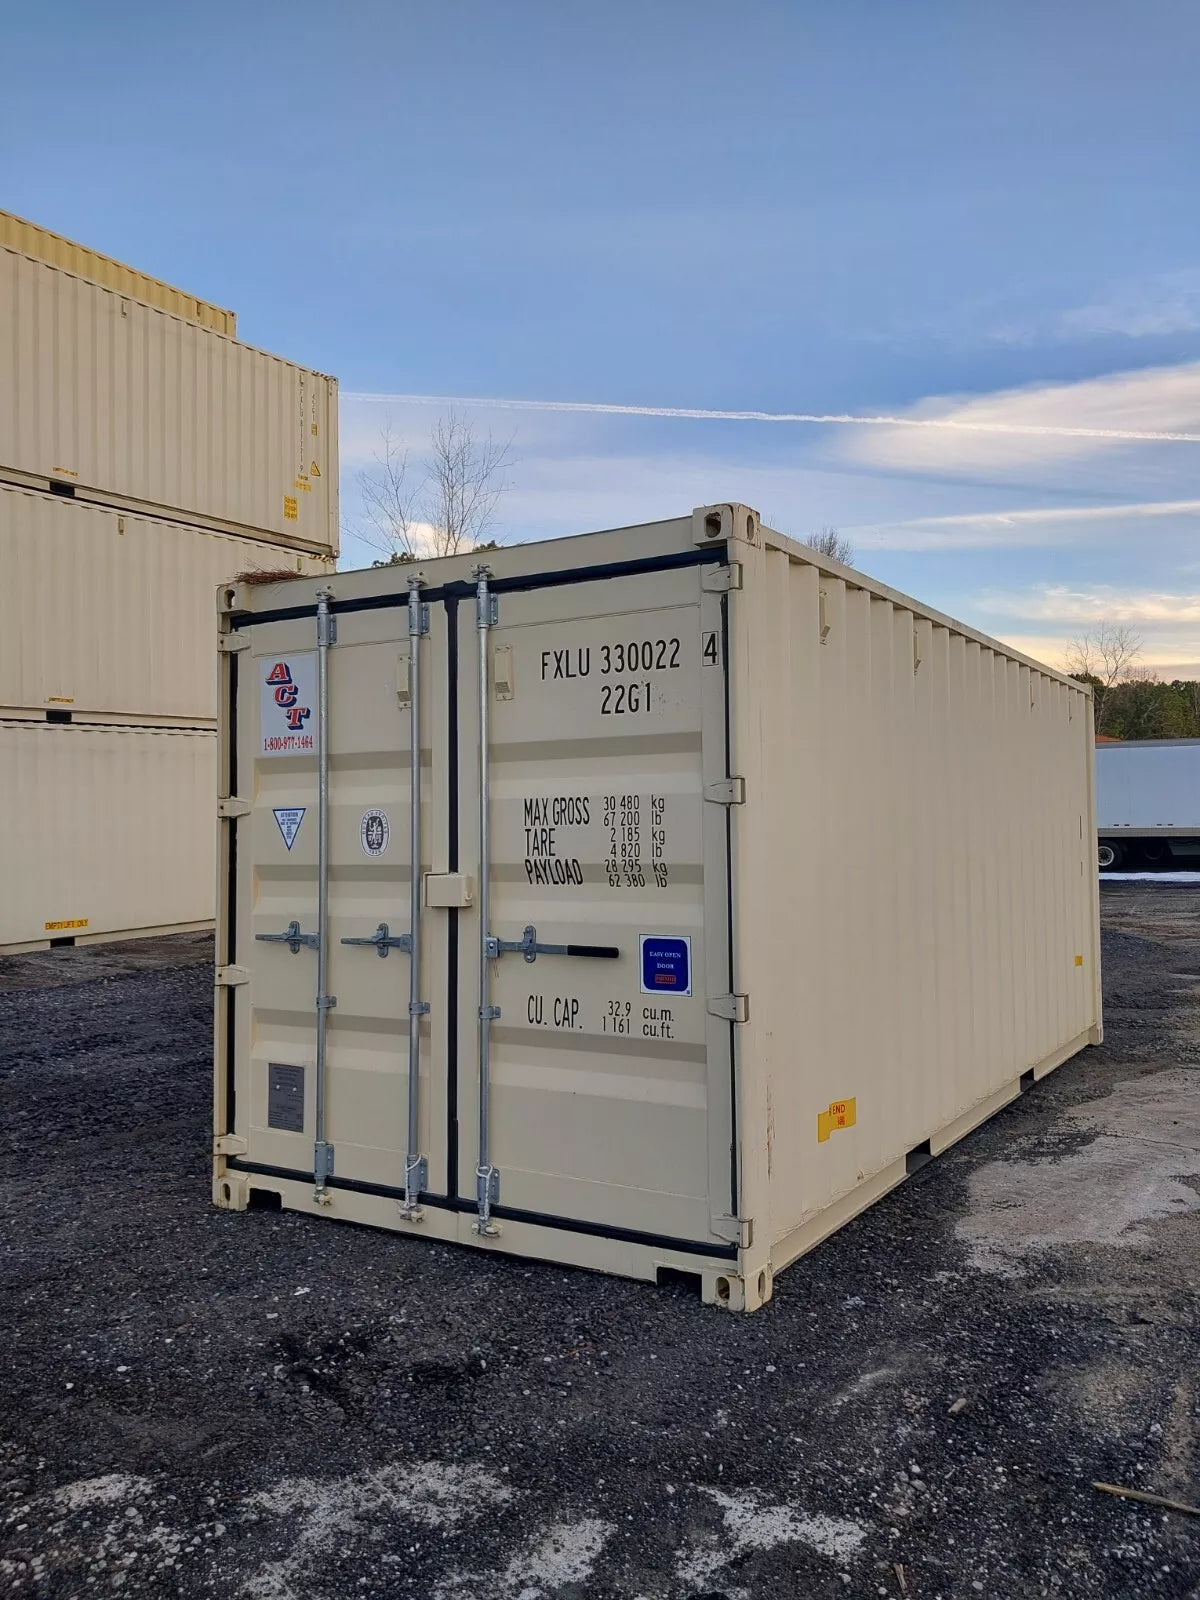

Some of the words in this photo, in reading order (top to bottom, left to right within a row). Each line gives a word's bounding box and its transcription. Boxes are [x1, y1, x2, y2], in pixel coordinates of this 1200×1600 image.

[541, 647, 590, 680] FXLU
[600, 638, 681, 674] 330022
[703, 633, 718, 664] 4
[265, 662, 311, 730] ACT
[601, 682, 651, 714] 22G1
[524, 798, 549, 826] MAX
[552, 797, 590, 826] GROSS
[603, 796, 616, 810] 30
[620, 795, 640, 810] 480
[651, 794, 665, 813] kg
[603, 812, 616, 826] 67
[620, 811, 640, 826] 200
[651, 810, 662, 825] lb
[525, 828, 556, 857] TARE
[610, 828, 616, 842] 2
[621, 827, 640, 842] 185
[651, 827, 665, 845] kg
[610, 843, 617, 857] 4
[621, 842, 640, 857] 820
[651, 843, 662, 857] lb
[525, 859, 583, 885] PAYLOAD
[605, 859, 618, 873] 28
[621, 859, 642, 873] 295
[652, 859, 668, 876] kg
[609, 874, 621, 888] 62
[626, 873, 645, 887] 380
[655, 874, 667, 887] lb
[528, 995, 547, 1025] CU.
[554, 997, 582, 1029] CAP.
[608, 1001, 631, 1017] 32.9
[643, 1007, 675, 1021] cu.m.
[643, 1022, 675, 1039] cu.ft.
